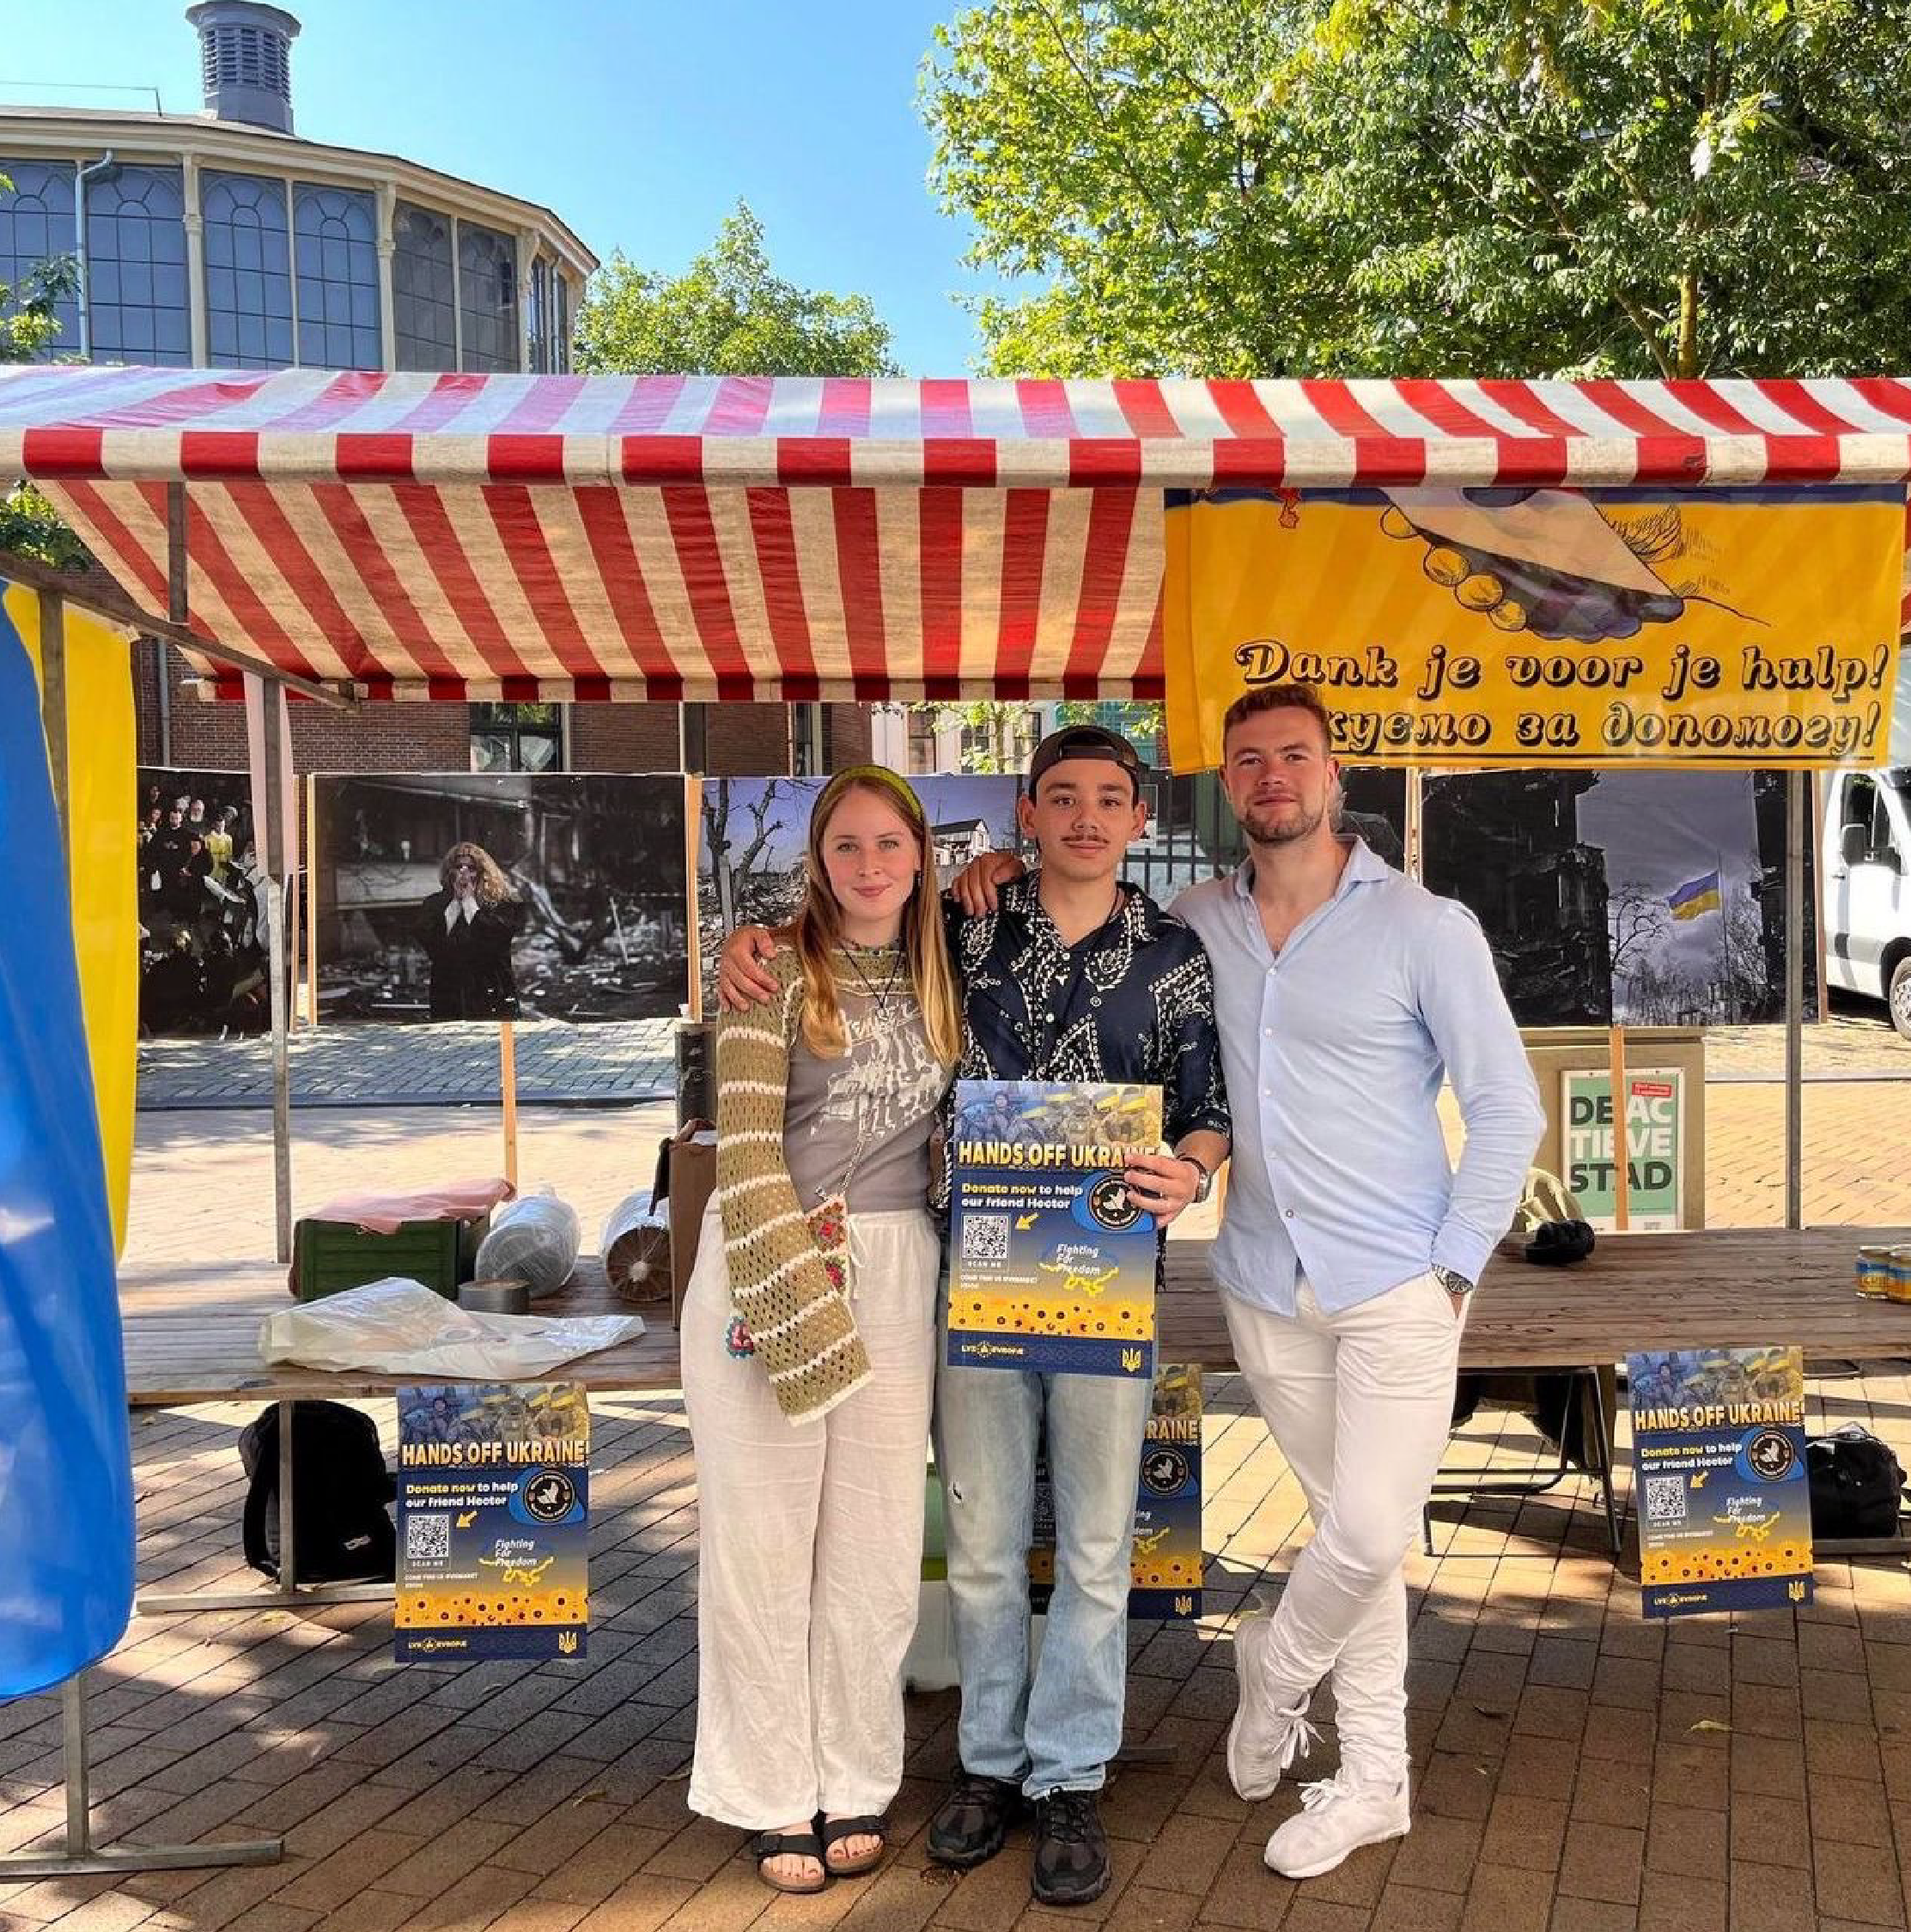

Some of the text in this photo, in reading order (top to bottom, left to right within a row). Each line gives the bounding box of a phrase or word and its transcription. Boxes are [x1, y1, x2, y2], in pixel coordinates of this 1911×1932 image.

[1235, 639, 1889, 703] Dank je voor je hulp!
[1328, 701, 1882, 756] куємо за допомогу!
[1571, 1095, 1672, 1126] DE AC
[959, 1141, 1024, 1164] HANDS
[1031, 1143, 1067, 1167] OFF
[1570, 1160, 1673, 1194] STAD
[961, 1182, 1084, 1197] Donate now to help
[961, 1195, 1071, 1209] our friend Hector
[1056, 1243, 1099, 1258] Fighting
[1635, 1406, 1689, 1431] HANDS
[1694, 1405, 1725, 1428] OFF
[402, 1443, 463, 1465] HANDS
[468, 1442, 502, 1463] OFF
[1641, 1442, 1743, 1457] Donate now to help
[1642, 1456, 1733, 1470] our friend Hector
[406, 1481, 519, 1495] Donate now to help
[405, 1495, 507, 1508] our friend Hector
[495, 1538, 534, 1551] Fighting
